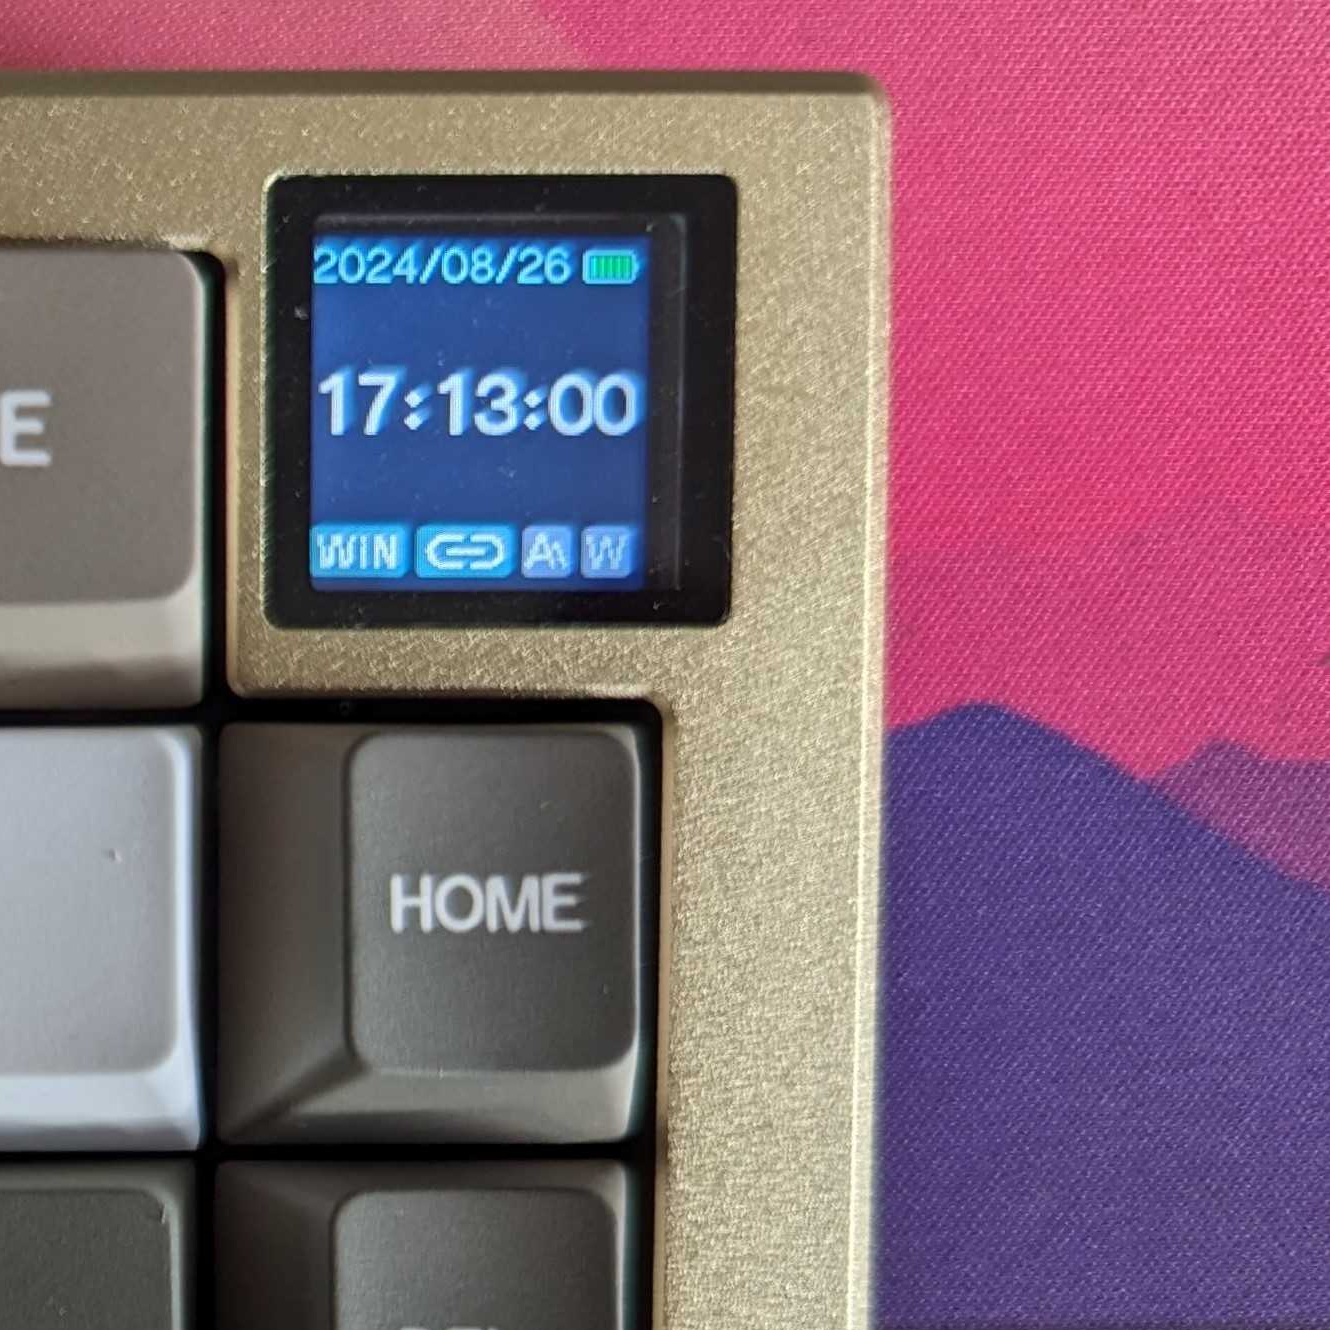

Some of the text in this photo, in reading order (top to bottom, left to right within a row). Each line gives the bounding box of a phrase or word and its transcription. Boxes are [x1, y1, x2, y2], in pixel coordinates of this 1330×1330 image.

[313, 247, 571, 284] 2024/08/26
[318, 369, 642, 436] 17:13:00
[317, 535, 398, 570] WIN
[585, 535, 628, 570] W
[389, 873, 589, 934] HOME
